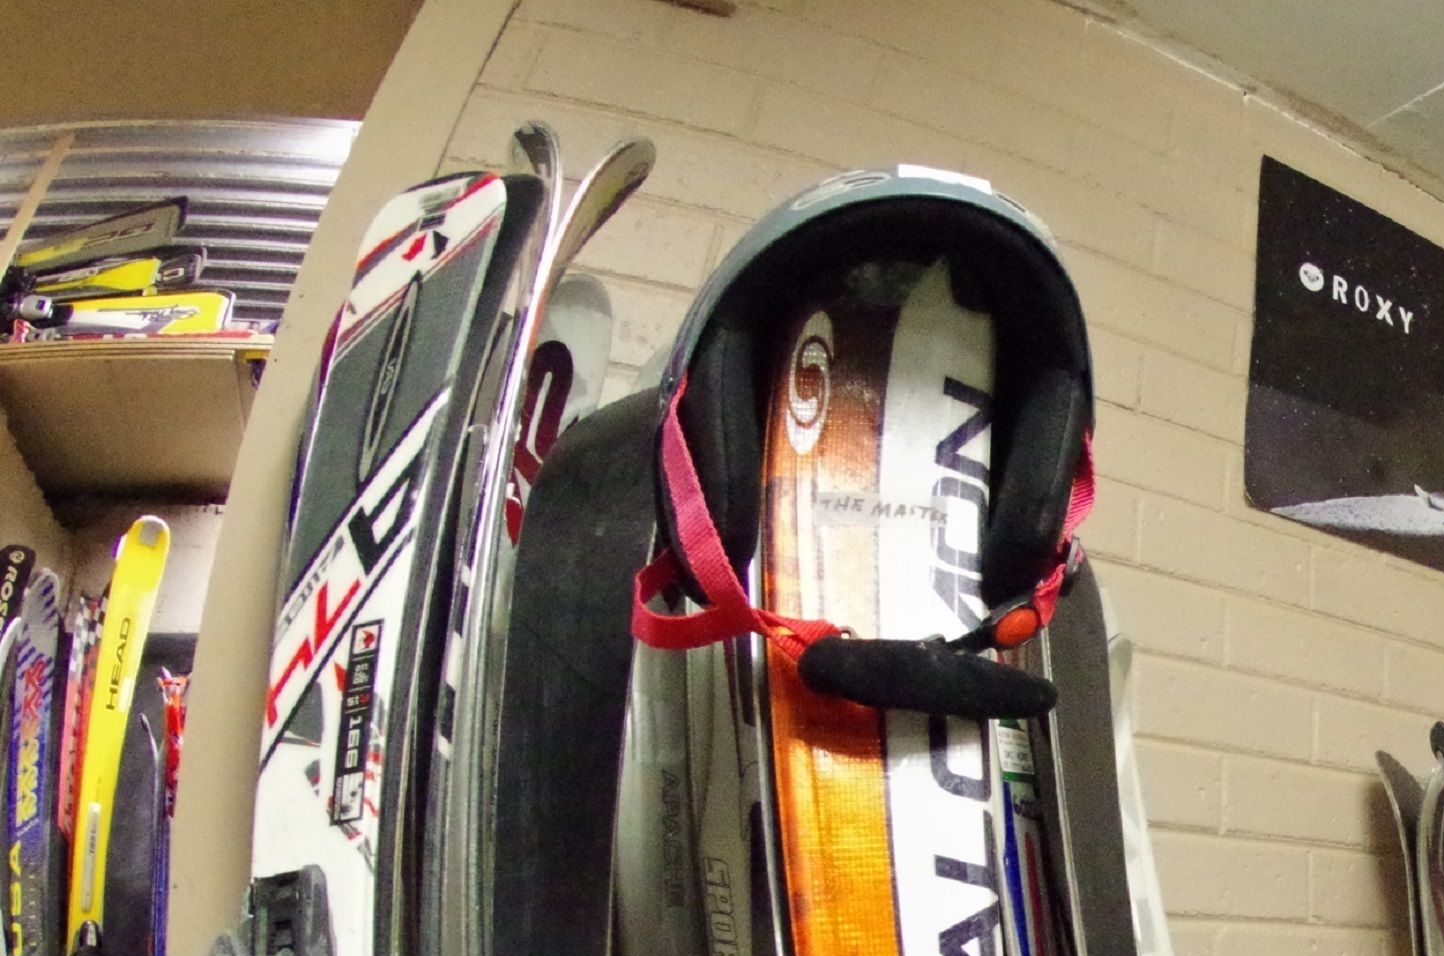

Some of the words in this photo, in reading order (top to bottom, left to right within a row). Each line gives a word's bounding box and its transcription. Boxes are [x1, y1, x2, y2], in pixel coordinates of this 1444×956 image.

[1332, 274, 1413, 335] ROXY
[819, 495, 866, 514] THE
[105, 616, 132, 711] HEAD
[344, 714, 363, 769] 166
